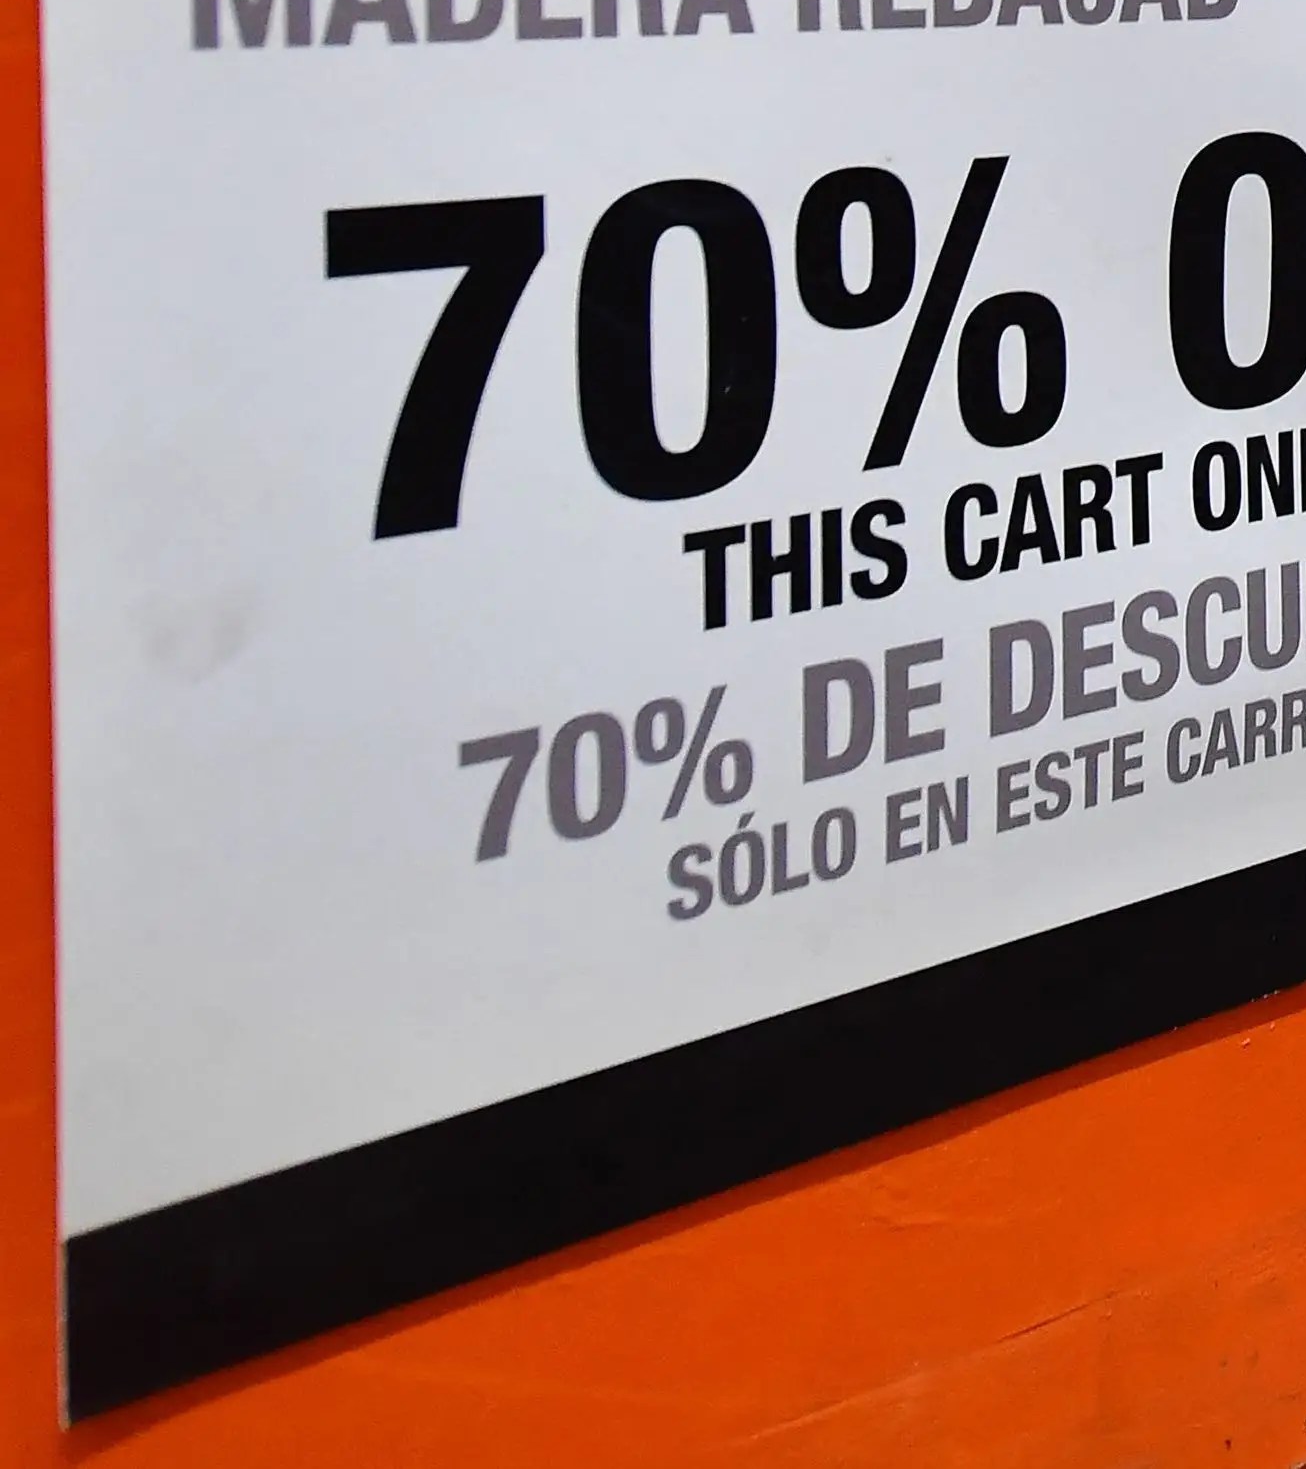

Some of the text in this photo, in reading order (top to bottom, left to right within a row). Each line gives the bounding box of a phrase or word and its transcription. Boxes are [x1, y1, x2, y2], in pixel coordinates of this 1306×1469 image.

[324, 155, 1068, 542] 70%
[683, 499, 908, 631] THIS
[944, 451, 1163, 581] CART
[458, 684, 754, 864] 70%
[803, 638, 945, 784] DE
[667, 812, 857, 921] SÓLO
[886, 776, 969, 865] EN
[996, 731, 1144, 834] ESTE
